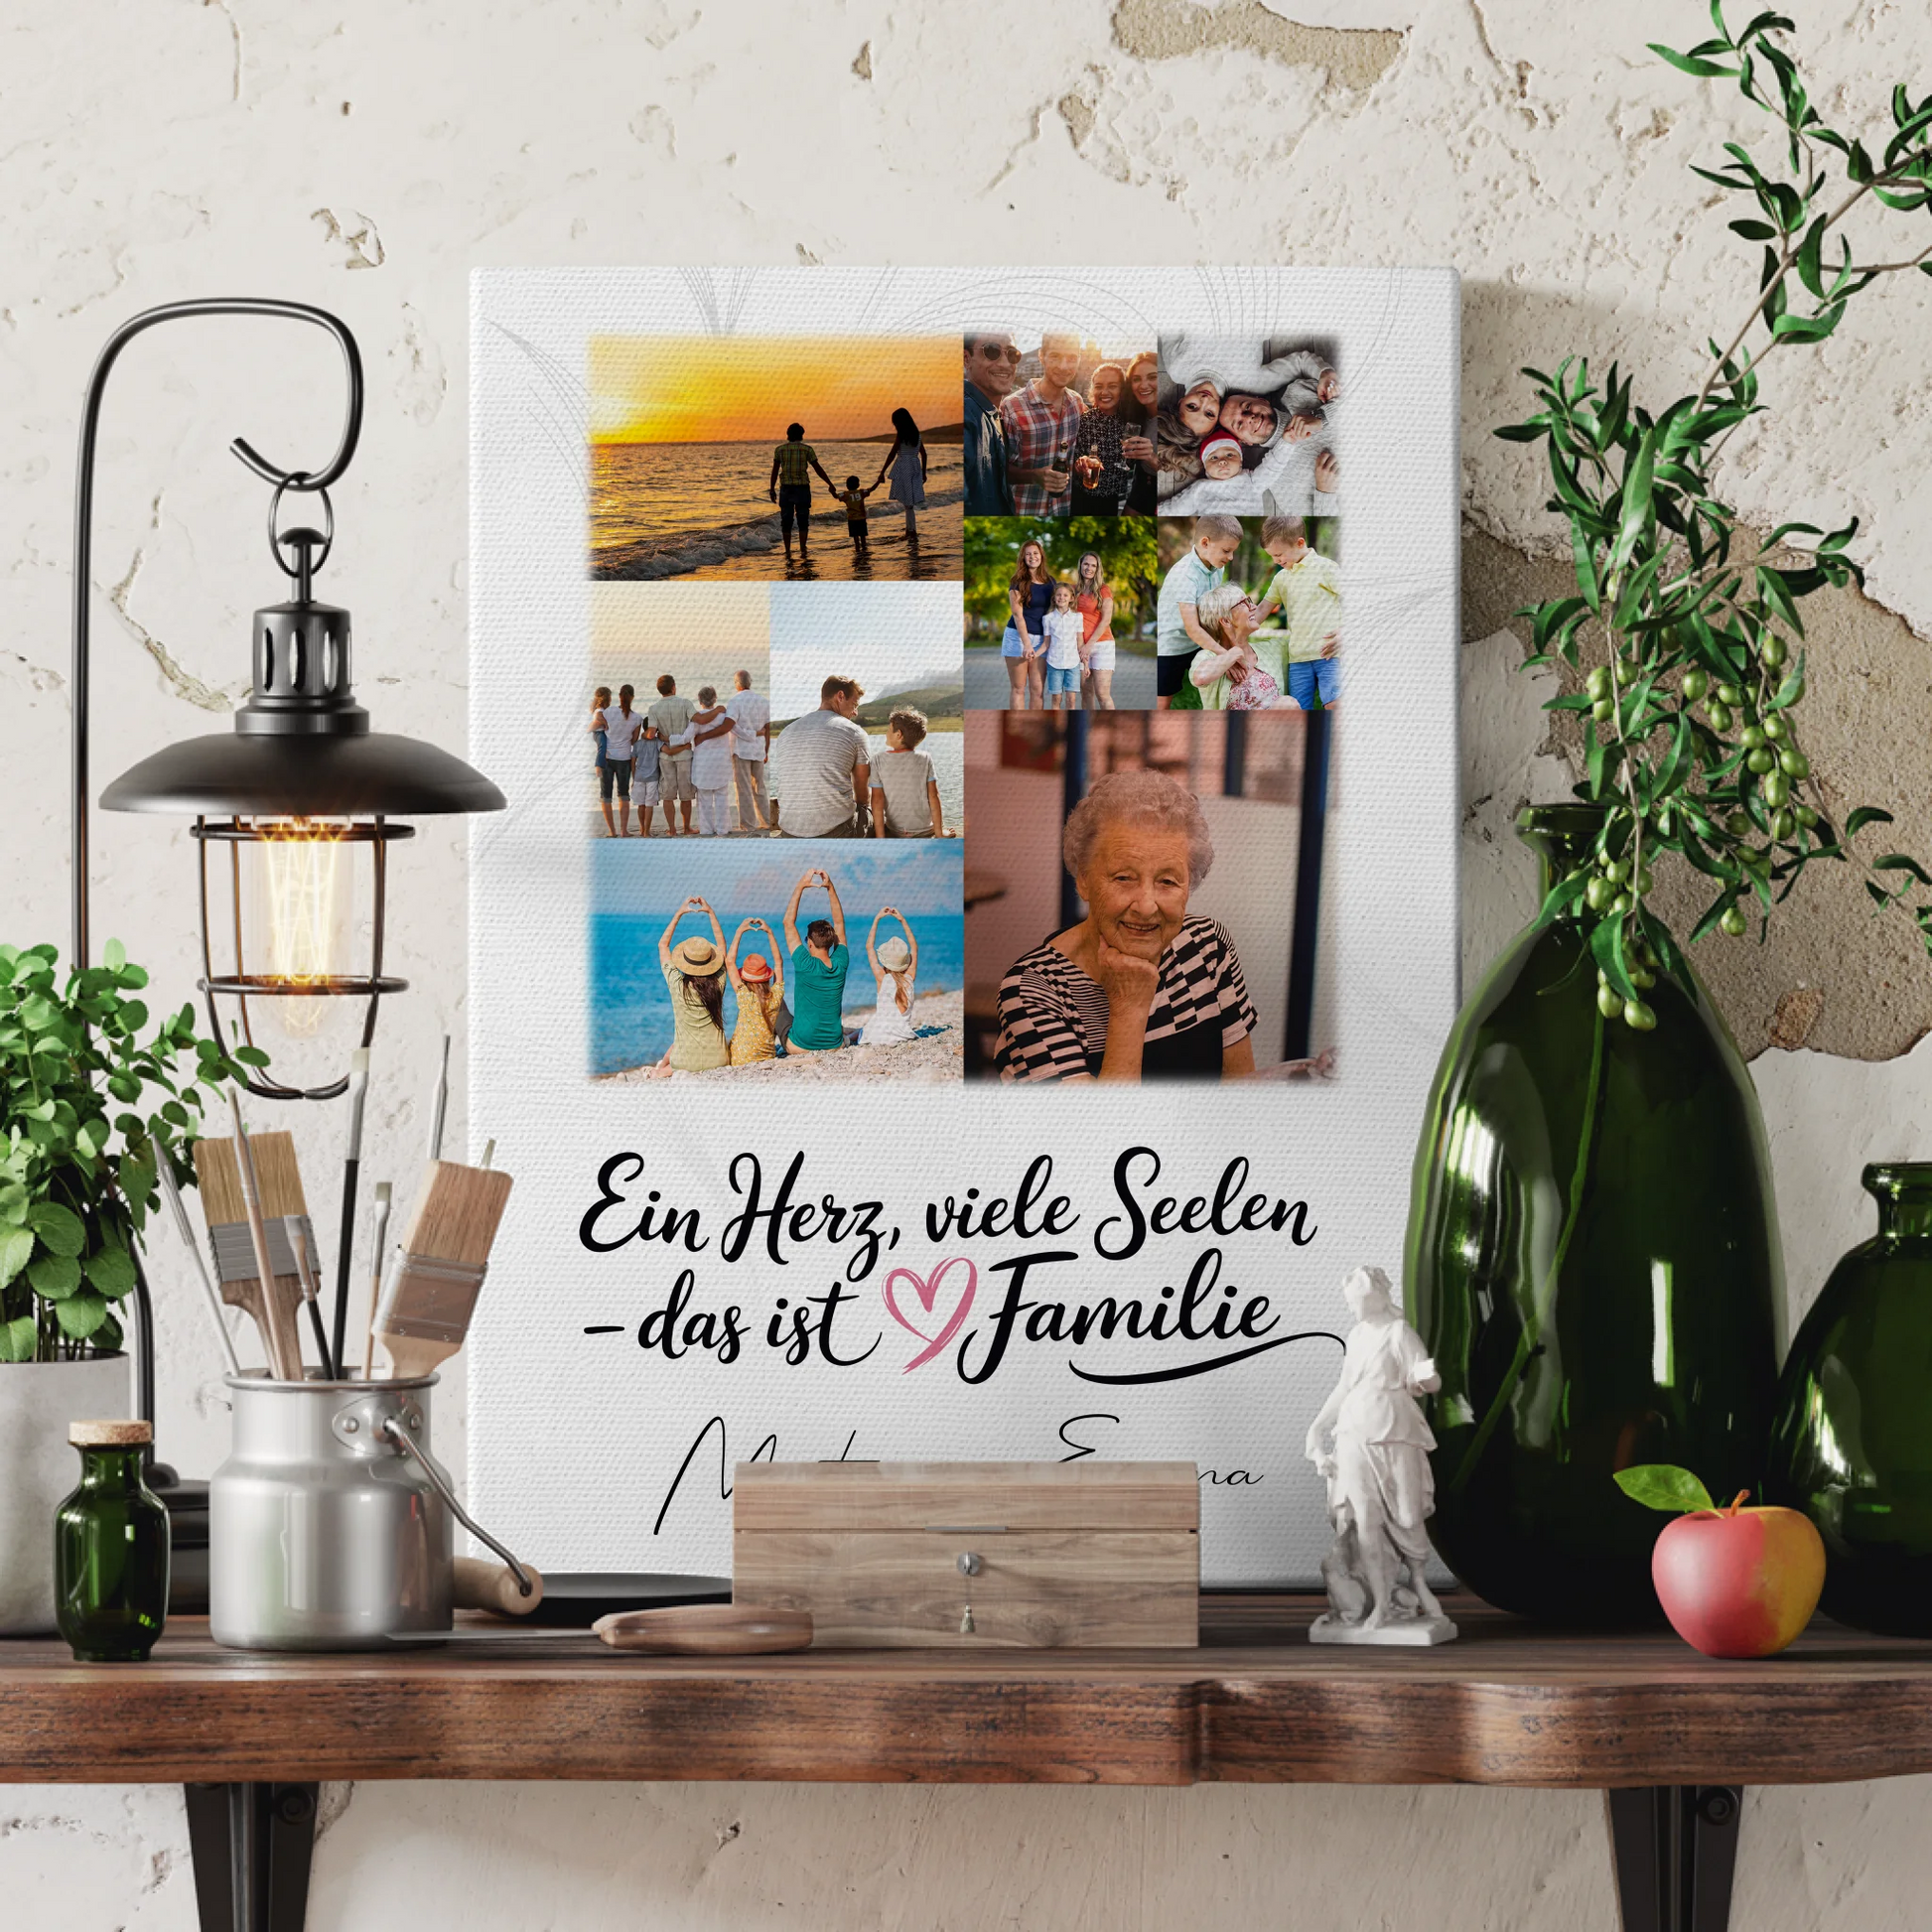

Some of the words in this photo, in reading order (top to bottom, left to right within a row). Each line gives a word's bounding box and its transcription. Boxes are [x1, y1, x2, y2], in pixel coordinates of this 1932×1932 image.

[849, 492, 862, 501] 19
[580, 1152, 709, 1253] Ein
[722, 1151, 899, 1282] Herz,
[926, 1155, 1080, 1243] viele
[1094, 1147, 1317, 1260] Seelen
[767, 1281, 882, 1366] ist
[957, 1248, 1281, 1385] Familie
